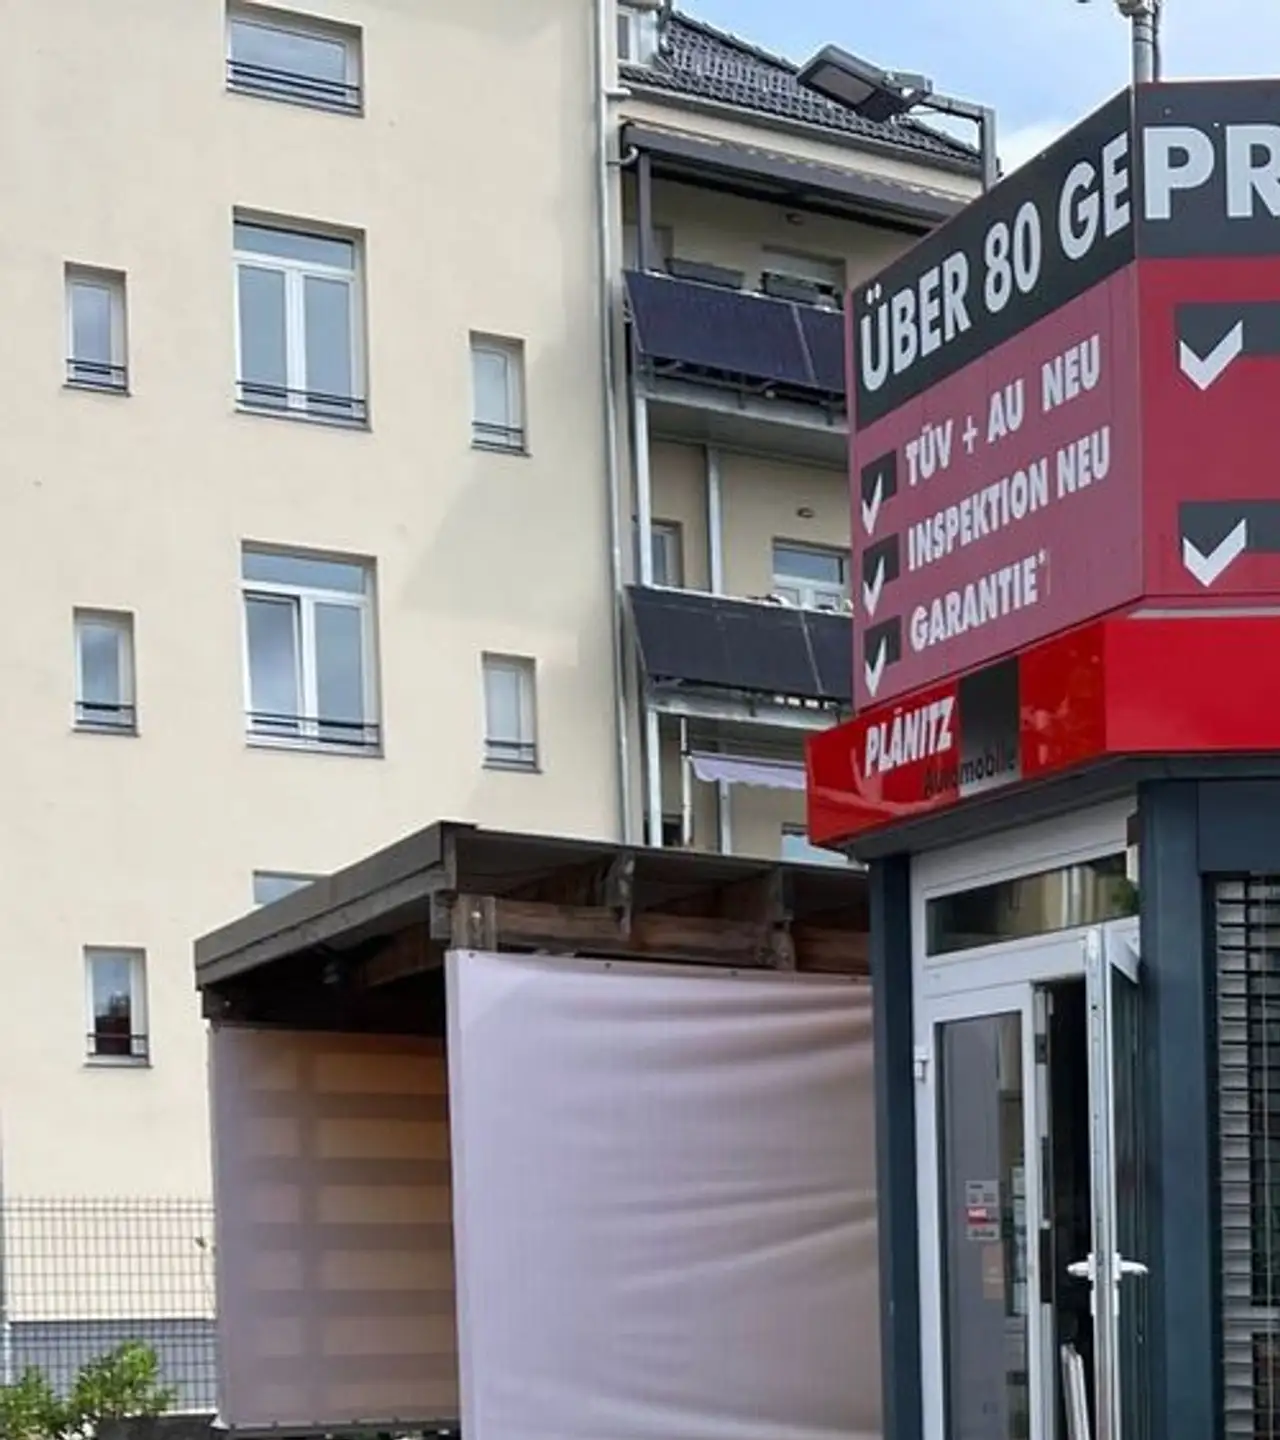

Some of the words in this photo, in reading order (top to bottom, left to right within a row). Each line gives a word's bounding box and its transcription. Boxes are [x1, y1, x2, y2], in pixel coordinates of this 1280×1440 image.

[860, 283, 970, 393] ÜBER
[984, 203, 1041, 314] 80
[905, 420, 952, 486] TÜV
[988, 382, 1024, 445] AU
[1042, 336, 1101, 411] NEU
[907, 457, 1049, 572] INSPEKTION
[1057, 426, 1111, 499] NEU
[864, 695, 956, 778] PLÄNITZ
